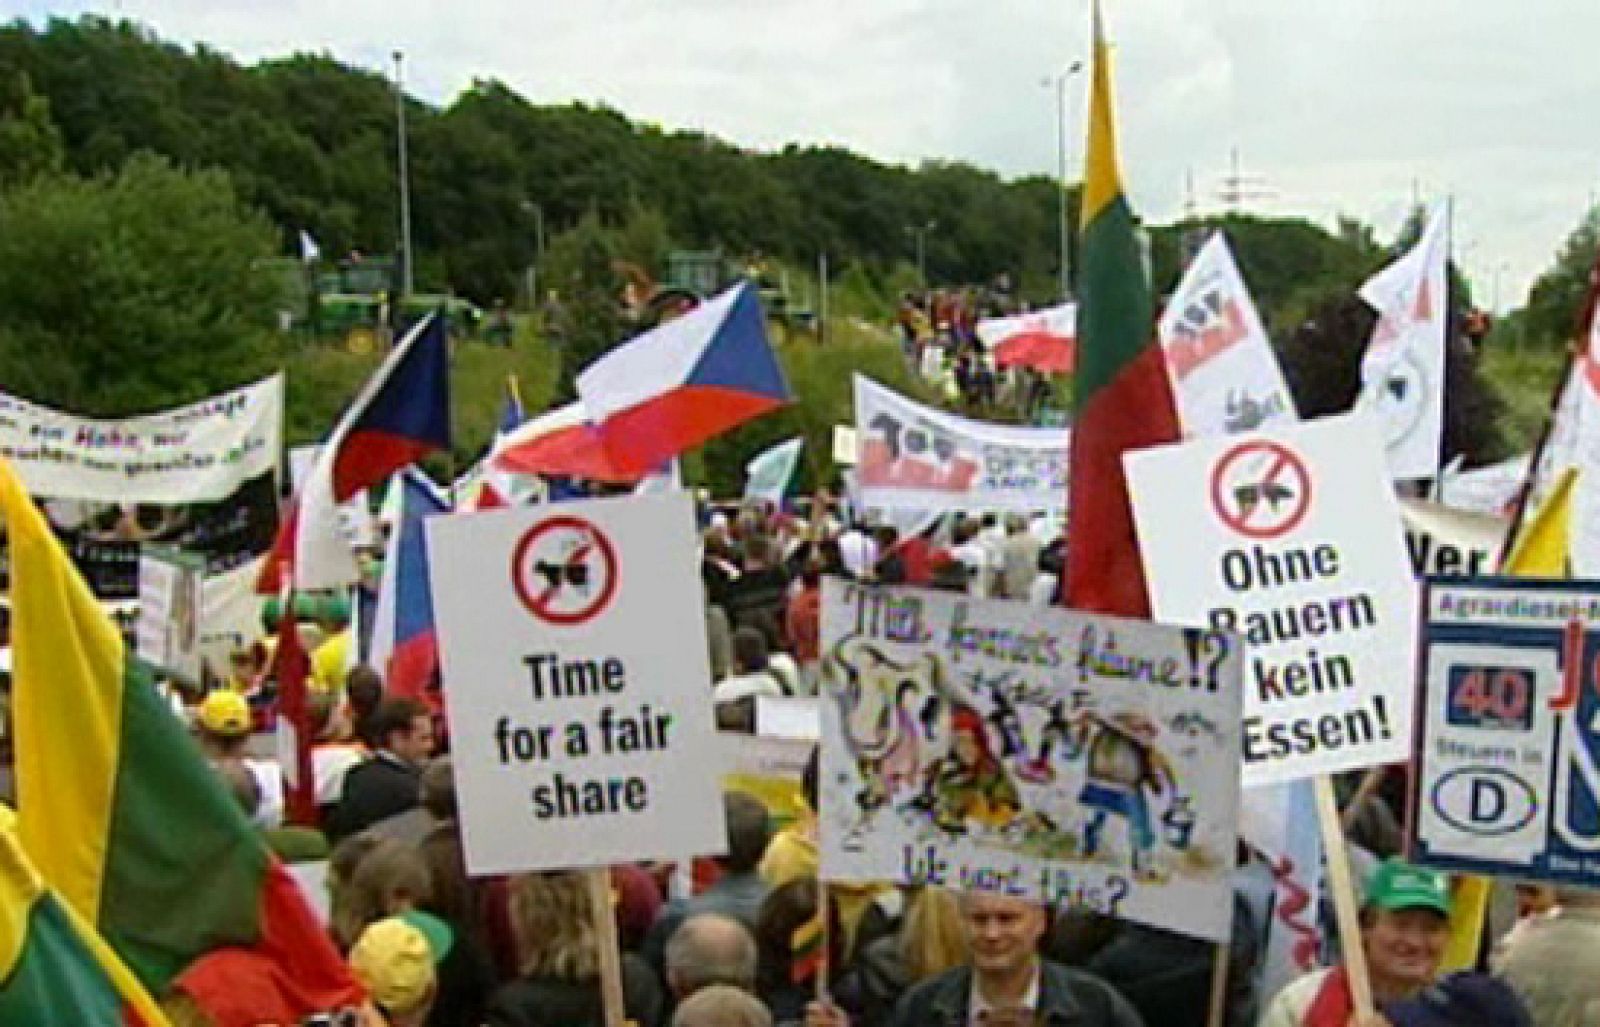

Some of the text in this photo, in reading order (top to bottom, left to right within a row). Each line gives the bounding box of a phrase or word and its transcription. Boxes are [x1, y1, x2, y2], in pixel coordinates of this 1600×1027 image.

[1222, 544, 1338, 592] Ohne
[522, 653, 625, 700] Time
[1254, 649, 1353, 702] kein
[1452, 670, 1530, 720] 40
[496, 705, 671, 764] for a fair
[1241, 694, 1391, 763] Essen!
[531, 773, 648, 818] share
[1471, 778, 1507, 822] D
